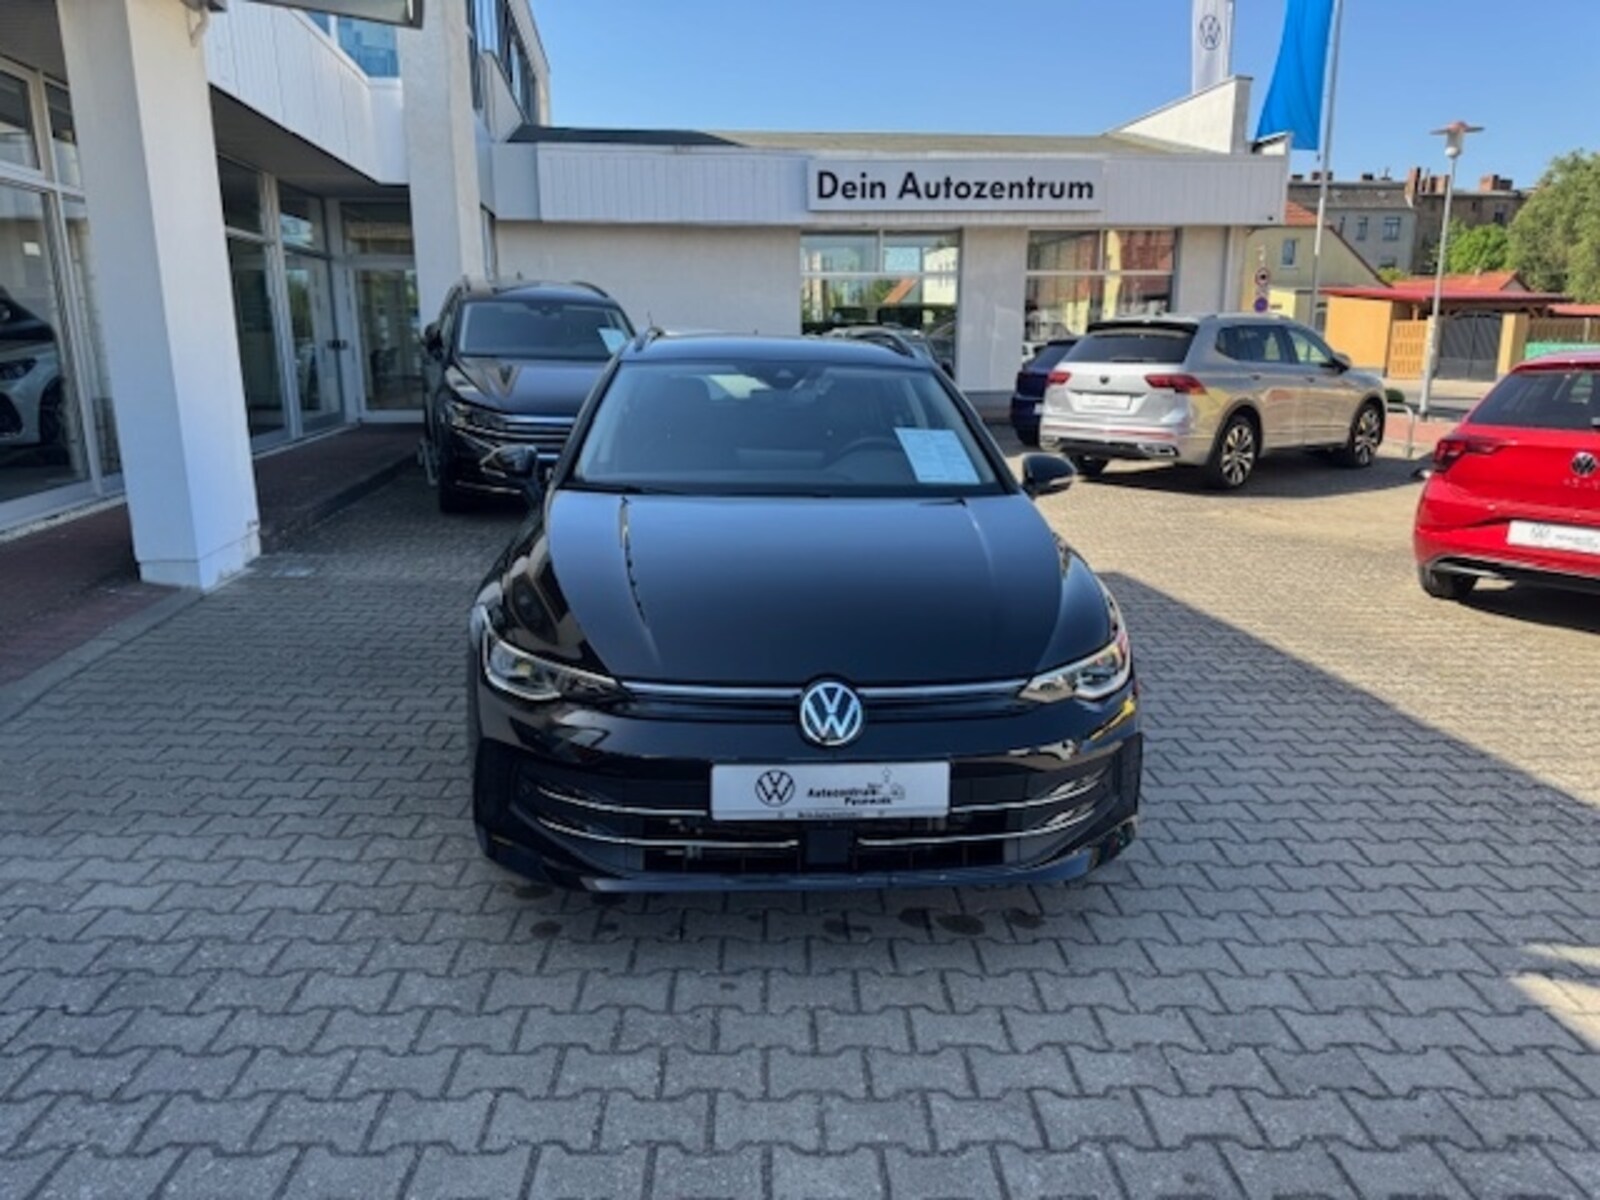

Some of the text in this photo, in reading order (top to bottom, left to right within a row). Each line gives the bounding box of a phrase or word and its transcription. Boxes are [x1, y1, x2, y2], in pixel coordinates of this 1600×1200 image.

[817, 171, 1094, 199] Dein Autozentrum
[802, 682, 861, 745] VW
[755, 770, 795, 807] VW
